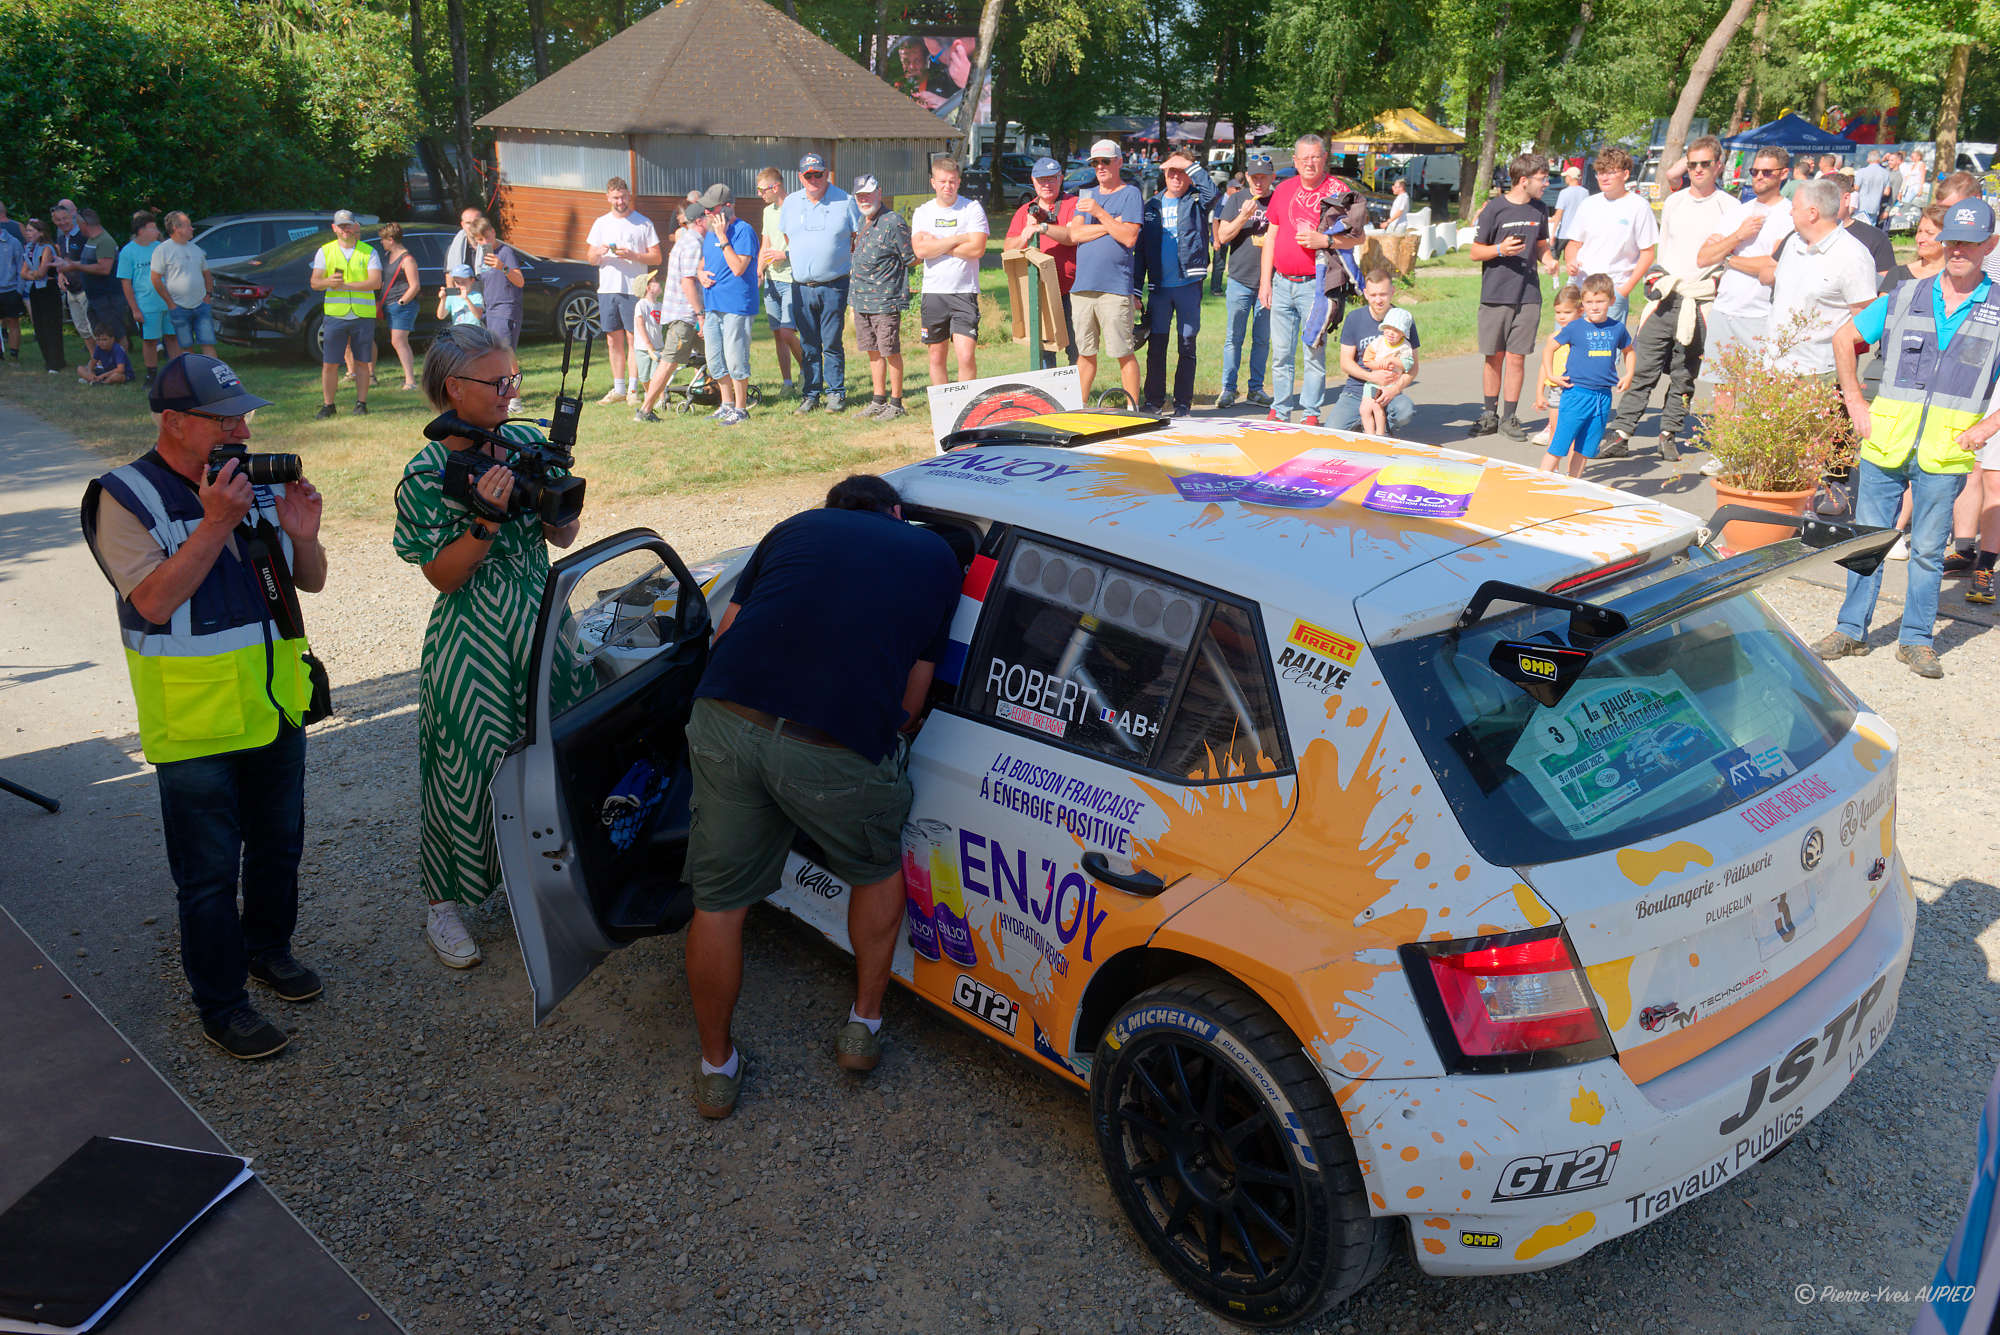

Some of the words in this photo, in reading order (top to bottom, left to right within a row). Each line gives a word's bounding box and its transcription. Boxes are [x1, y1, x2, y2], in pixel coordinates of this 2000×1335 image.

[944, 385, 966, 393] FFSA
[1053, 369, 1074, 377] FFSA
[920, 453, 1082, 482] ENJOY
[1253, 481, 1334, 497] ENJOY
[1374, 490, 1459, 506] ENJOY
[262, 567, 279, 601] Canon
[1294, 624, 1356, 661] PIRELLI
[1277, 646, 1352, 690] RALLYE
[1521, 658, 1555, 676] OMP
[985, 657, 1097, 725] ROBERT
[1600, 689, 1637, 722] RALLYE
[1116, 710, 1160, 738] AB+
[1548, 726, 1566, 744] 3
[992, 753, 1012, 775] LA
[1008, 759, 1067, 795] BOISSON
[1061, 778, 1145, 824] FRANÇAISE
[1740, 796, 1791, 833] ECURIE
[1776, 773, 1837, 814] BRETAGNE
[980, 772, 989, 800] À
[993, 778, 1055, 825] ÉNERGIE
[1056, 804, 1130, 854] POSITIVE
[959, 828, 1108, 962] ENJOY
[1636, 880, 1714, 920] Boulangerie
[1723, 852, 1774, 888] Pâtisserie
[938, 919, 968, 941] ENJOY
[1000, 911, 1046, 956] HYDRATION
[1045, 942, 1070, 979] REMEDY
[952, 974, 1020, 1037] GT2i
[1128, 1009, 1210, 1036] MICHELIN
[1222, 1040, 1251, 1066] PILOT
[1250, 1065, 1281, 1102] SPORT
[1719, 975, 1886, 1135] JSTP
[1850, 1041, 1864, 1072] LA
[1491, 1140, 1622, 1203] GT2i
[1626, 1157, 1729, 1224] Travaux
[1735, 1105, 1805, 1170] Publics
[1462, 1233, 1500, 1246] OMP
